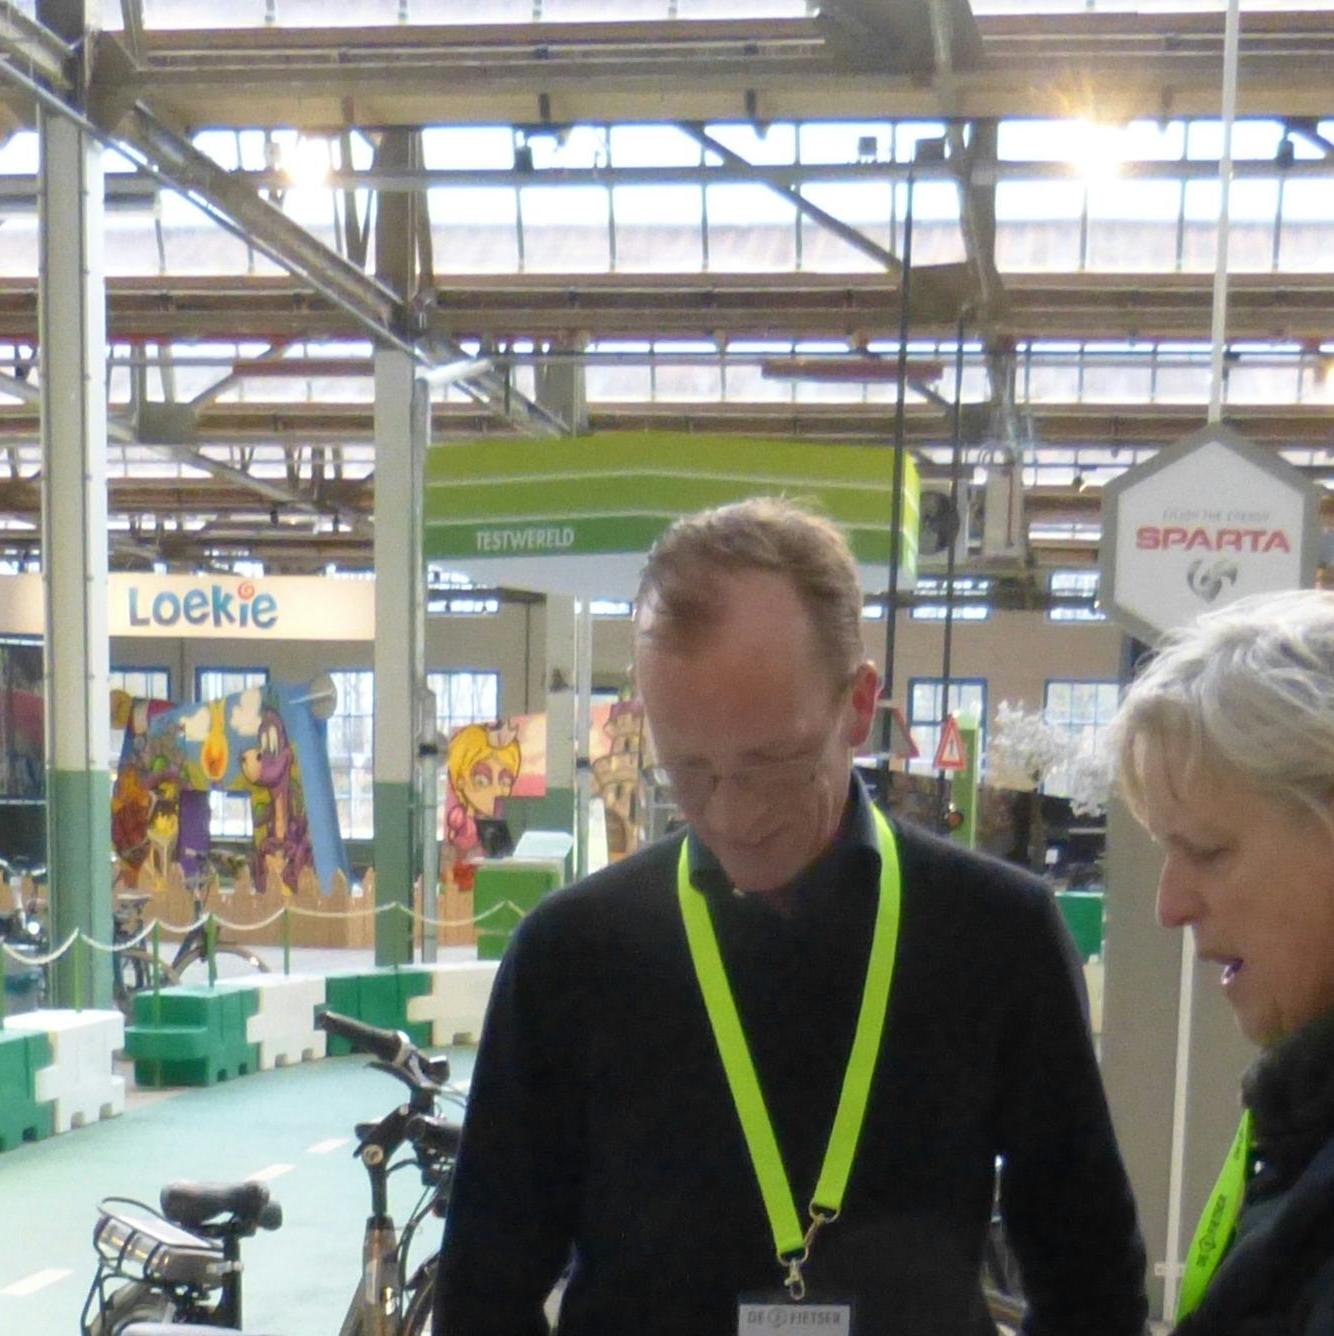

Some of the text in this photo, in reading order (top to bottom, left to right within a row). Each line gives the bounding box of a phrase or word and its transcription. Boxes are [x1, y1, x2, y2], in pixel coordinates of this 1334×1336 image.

[476, 527, 575, 551] TESTWERELD
[1135, 526, 1291, 554] SPARTA
[128, 580, 279, 629] Loekie
